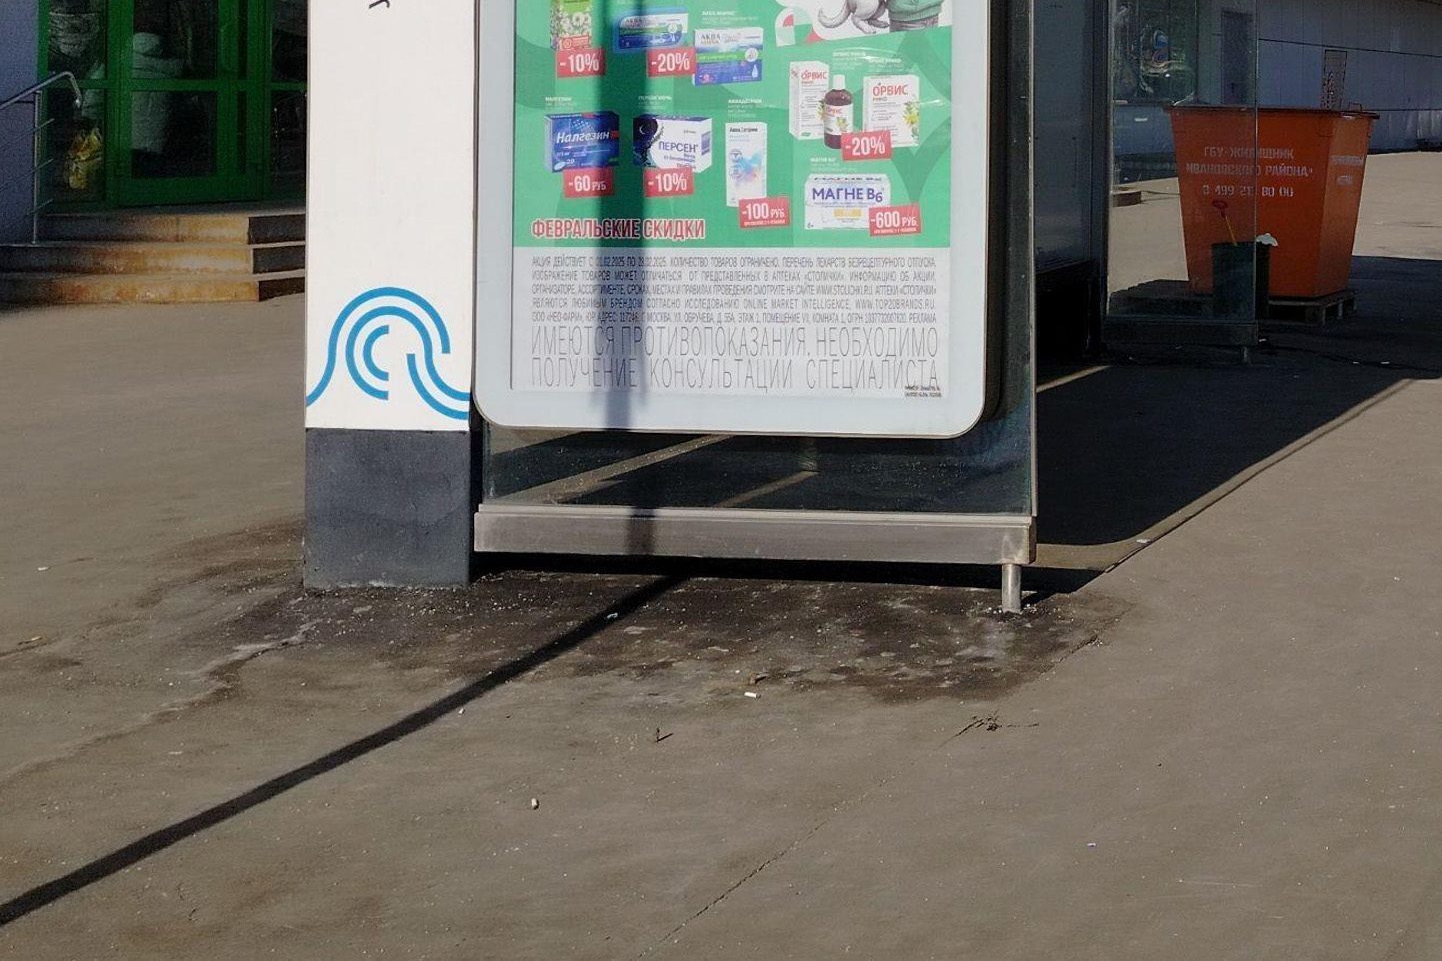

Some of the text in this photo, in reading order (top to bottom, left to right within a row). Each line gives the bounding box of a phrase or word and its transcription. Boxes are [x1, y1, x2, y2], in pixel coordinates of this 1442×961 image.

[560, 52, 600, 73] -10%
[651, 52, 690, 73] -20%
[873, 83, 909, 96] ОРВИС
[556, 130, 610, 144] Налгезин
[846, 136, 886, 156] -20%
[658, 140, 697, 154] ПЕРСЕН
[1204, 146, 1224, 158] ГБУ
[568, 175, 591, 192] -60
[647, 173, 687, 193] -10%
[812, 187, 864, 201] МАГНЕ
[742, 203, 769, 220] -100
[871, 211, 900, 229] -600
[531, 218, 706, 241] ФЕВРАЛЬСКИЕ СКИДКИ
[531, 325, 938, 357] ИМЕЮТСЯ ПРОТИВОПОКАЗАНИЯ. НЕОБХОДИМО
[531, 357, 939, 393] ПОЛУЧЕНИЕ КОНСУЛЬТАЦИИ СПЕЦИАЛИСТА
